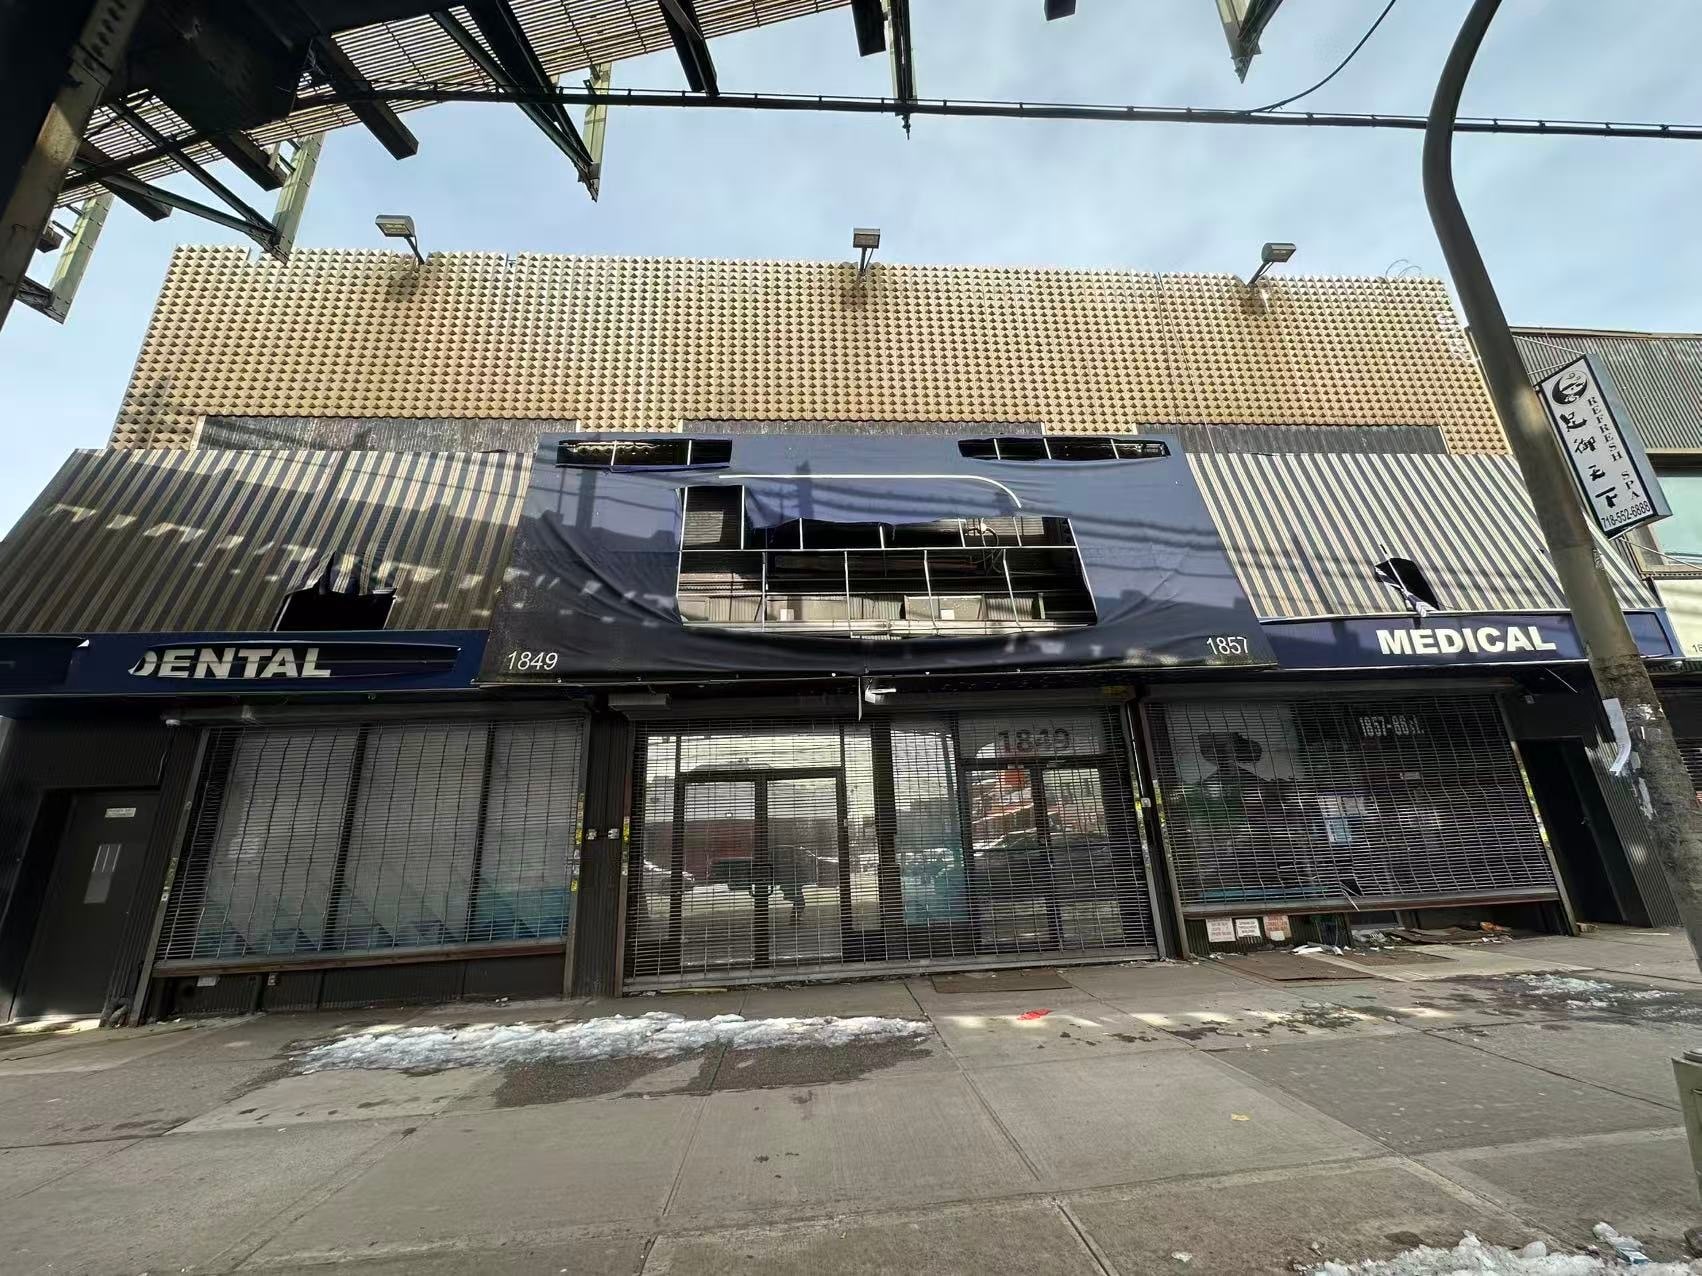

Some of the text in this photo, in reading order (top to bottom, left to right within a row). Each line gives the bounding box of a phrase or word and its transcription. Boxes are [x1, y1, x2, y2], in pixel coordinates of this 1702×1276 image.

[1587, 396, 1640, 500] REFRESH SPA
[1601, 500, 1651, 529] 718-552-6888
[1206, 636, 1249, 655] 1857
[1376, 626, 1557, 655] MEDICAL
[128, 648, 332, 679] DENTAL
[508, 650, 558, 671] 1849
